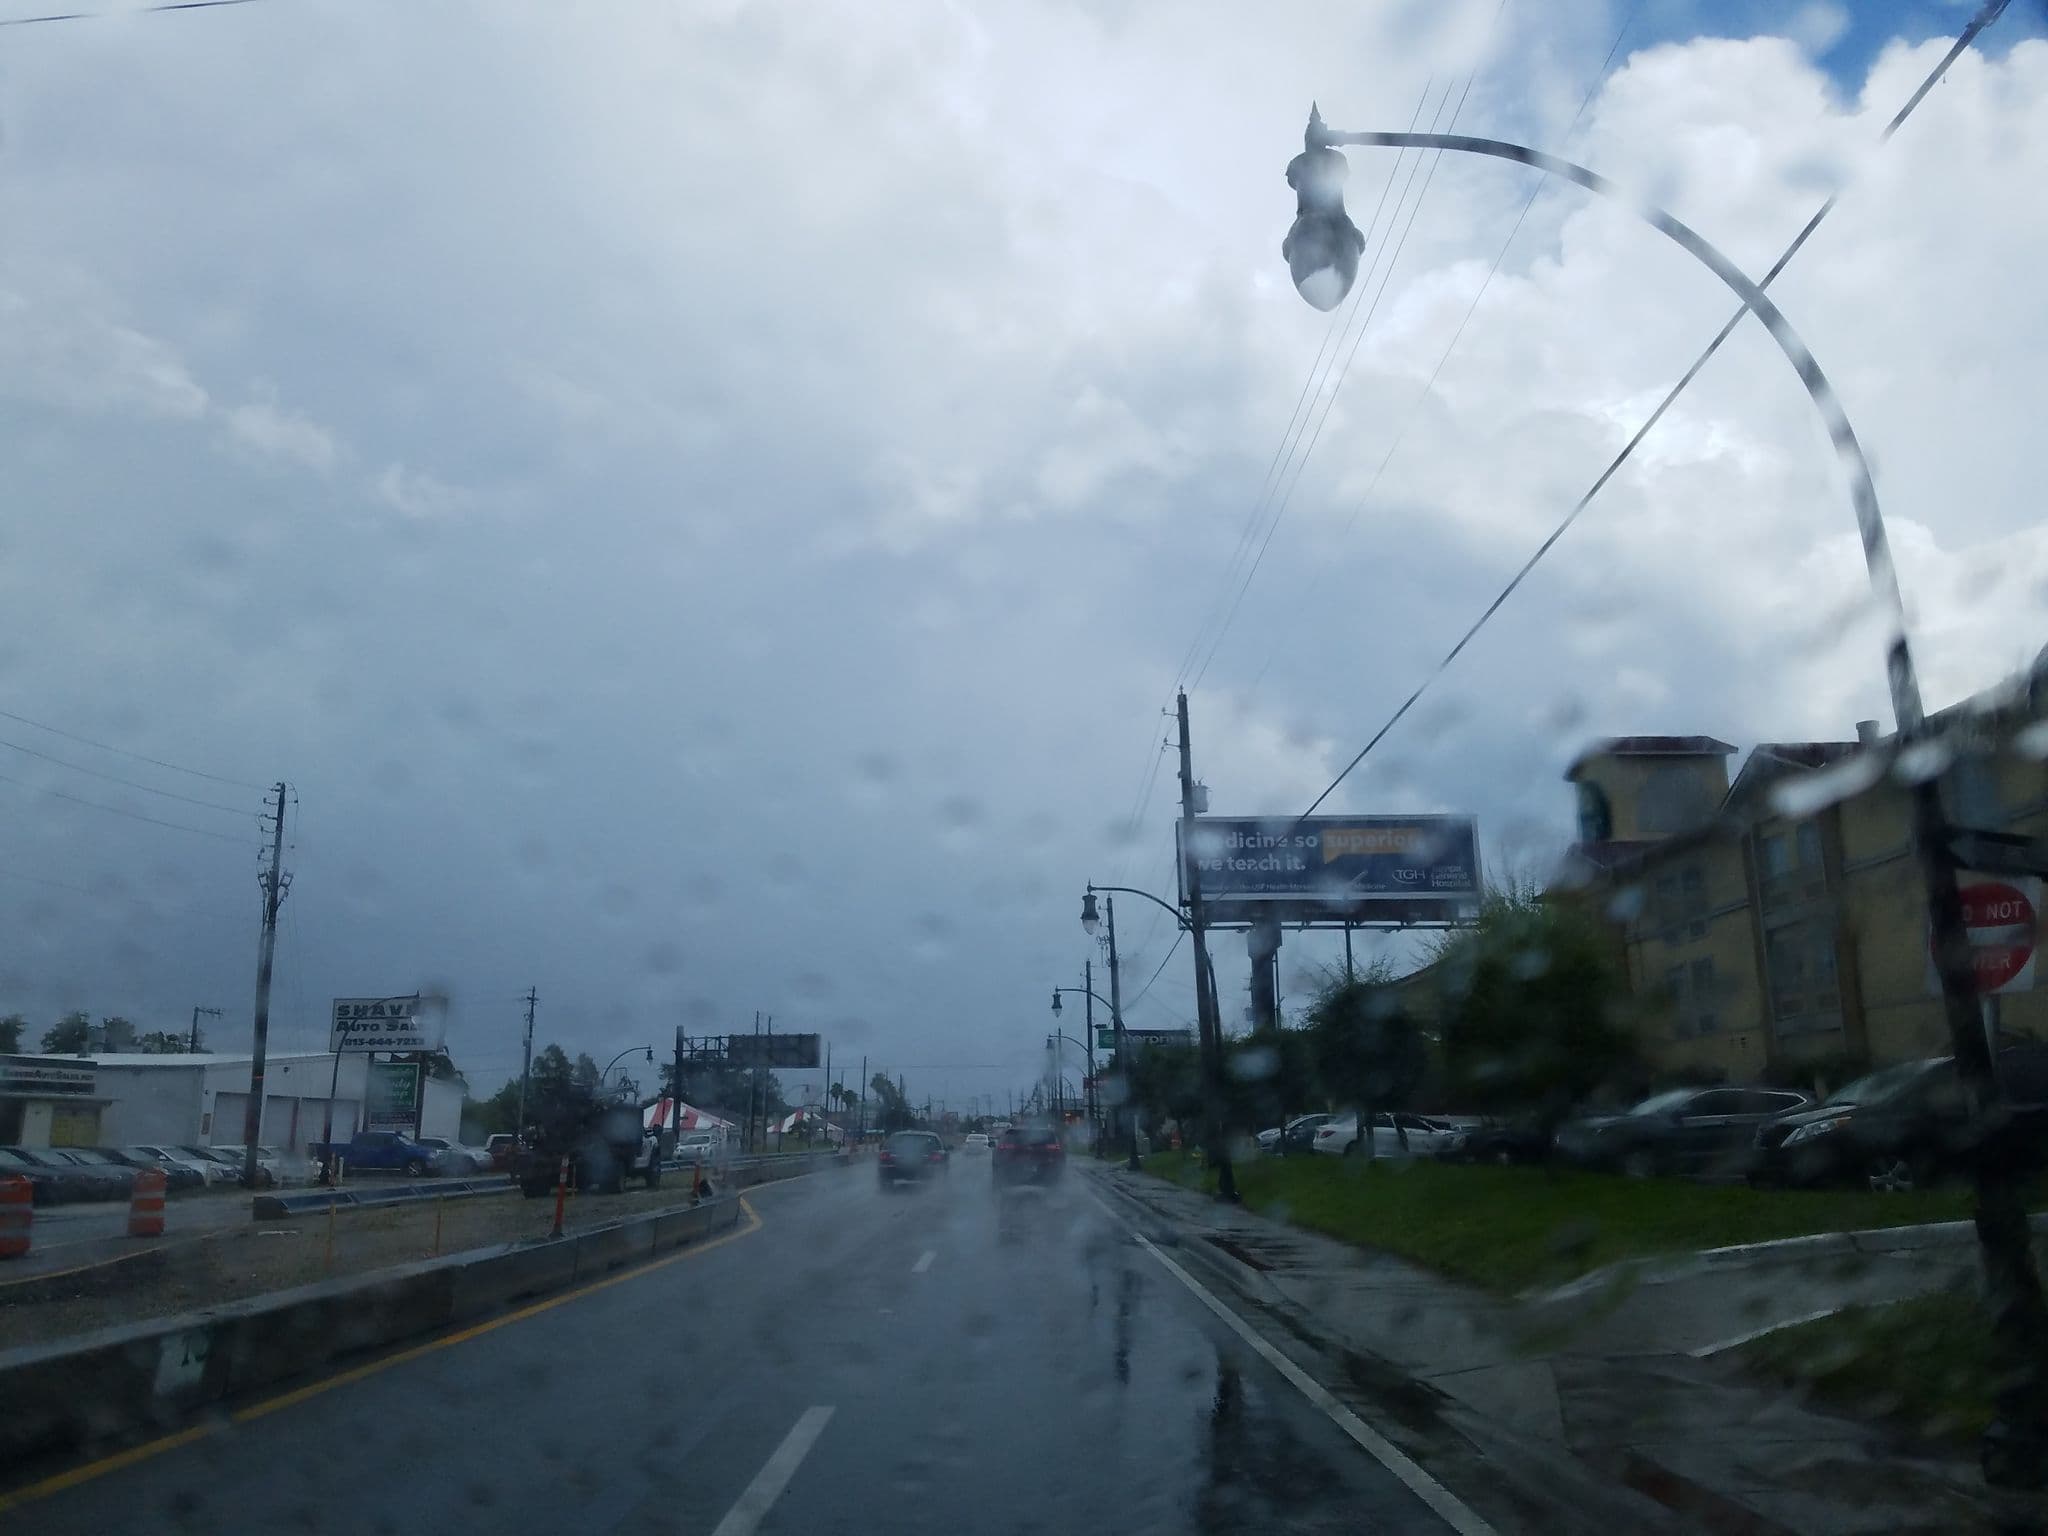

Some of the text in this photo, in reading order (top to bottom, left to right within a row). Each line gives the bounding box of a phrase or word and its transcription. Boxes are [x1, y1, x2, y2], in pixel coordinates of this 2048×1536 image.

[1295, 835, 1318, 849] so
[1198, 857, 1222, 872] we
[1226, 853, 1281, 872] teach
[1396, 869, 1425, 880] TGH
[1986, 901, 2023, 921] NOT
